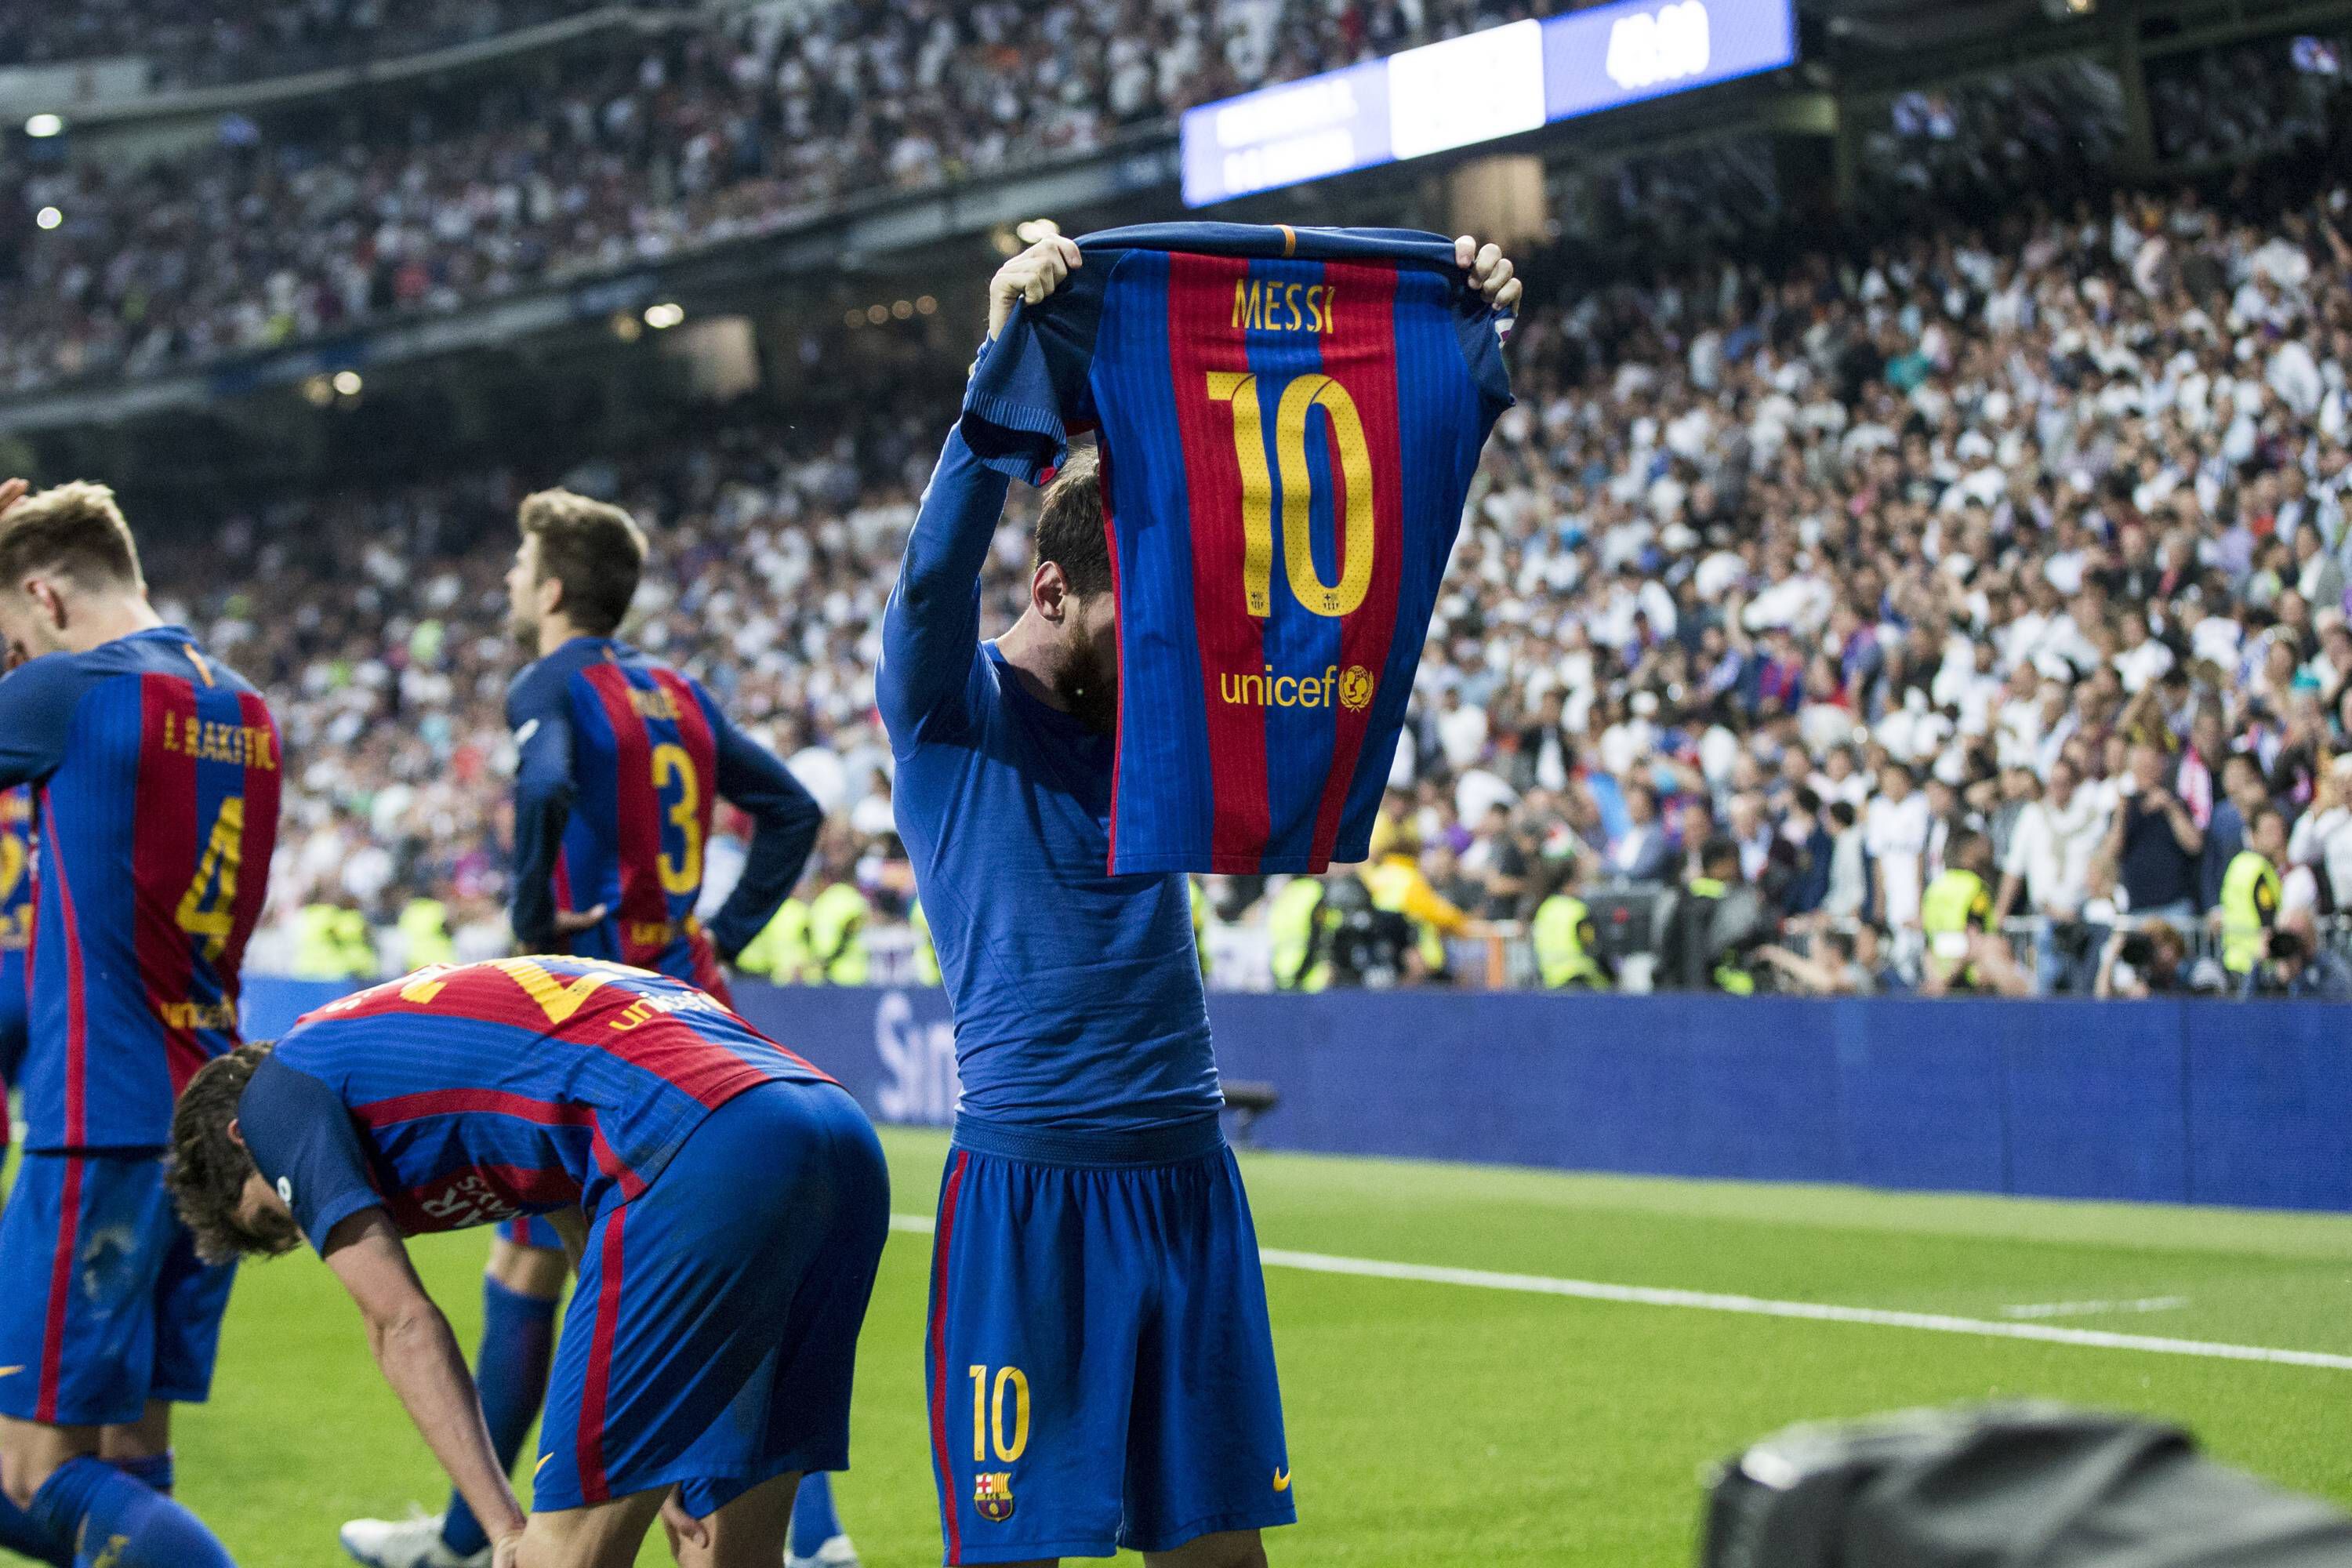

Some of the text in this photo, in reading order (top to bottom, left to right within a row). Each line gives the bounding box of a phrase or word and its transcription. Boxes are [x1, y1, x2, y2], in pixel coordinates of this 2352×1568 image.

[1232, 278, 1335, 334] MESSI
[1207, 371, 1374, 618] 10
[1221, 665, 1337, 707] unicef
[175, 797, 245, 962] 4
[651, 743, 702, 894] 3
[969, 1365, 1030, 1461] 10
